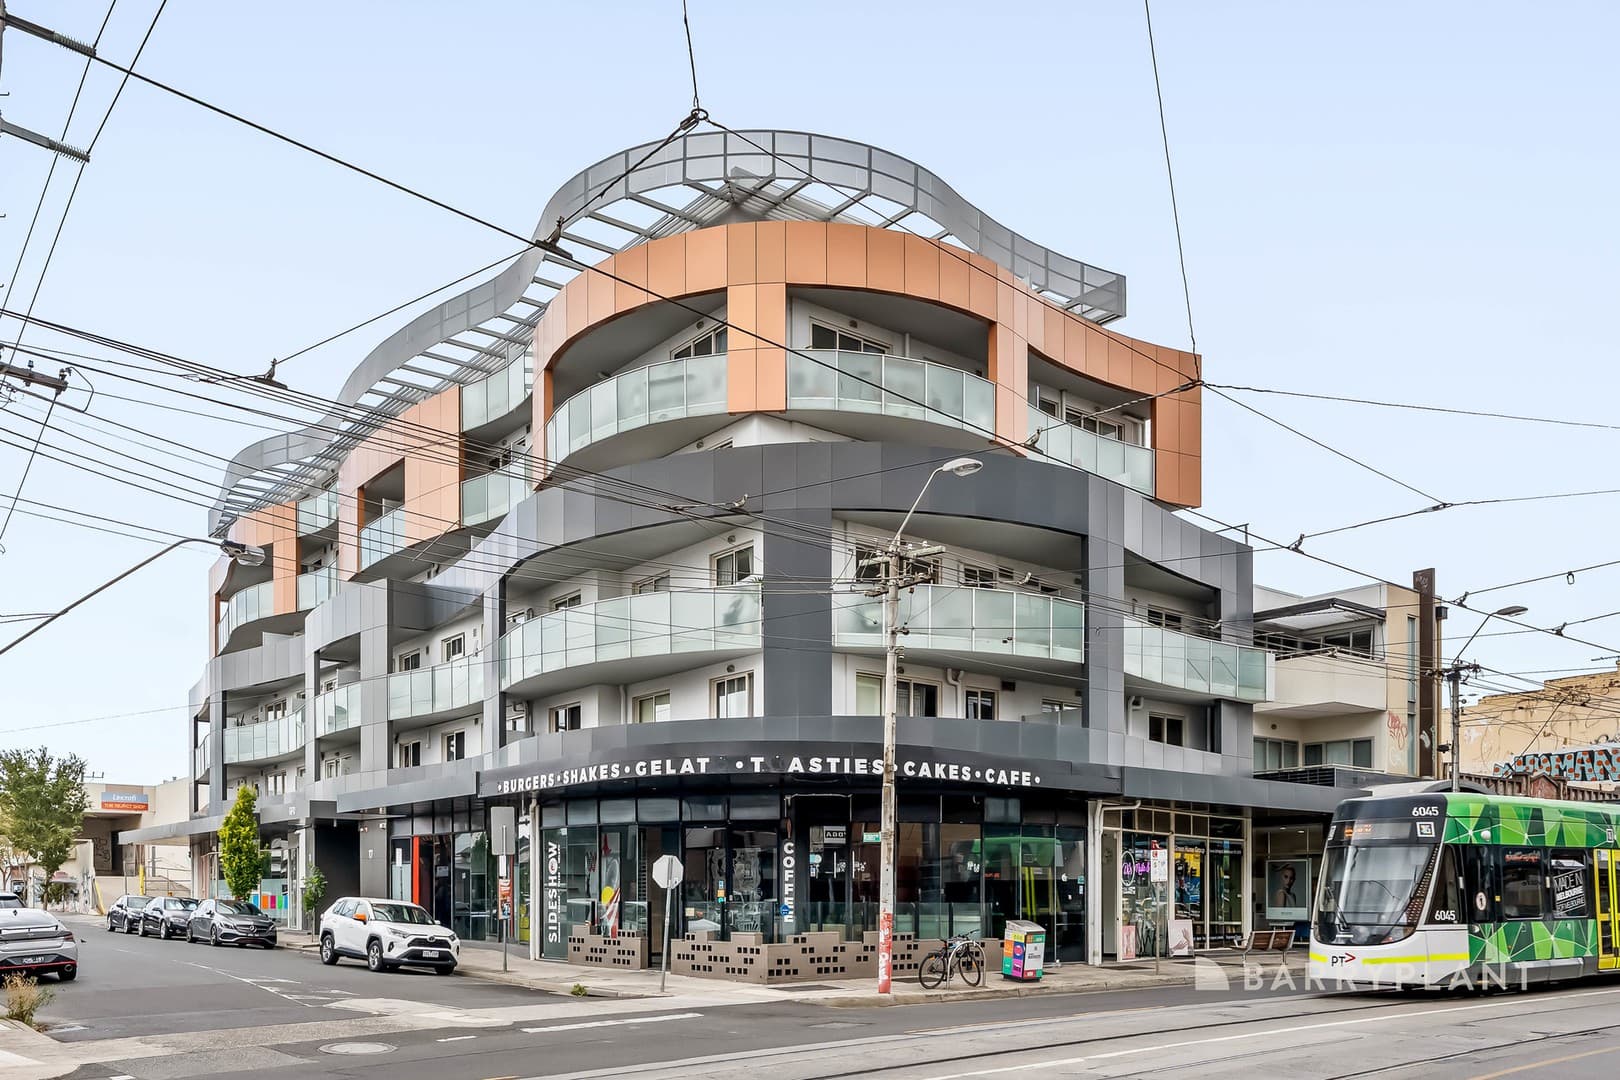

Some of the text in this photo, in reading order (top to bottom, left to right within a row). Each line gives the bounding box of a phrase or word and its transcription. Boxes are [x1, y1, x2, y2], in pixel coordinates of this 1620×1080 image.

[503, 773, 554, 794] BURGERS
[563, 763, 620, 785] SHAKES
[635, 757, 710, 776] GELAT
[903, 761, 972, 781] CAKES
[985, 768, 1031, 786] CAFE
[1412, 806, 1439, 817] 6045
[548, 841, 558, 943] SIDESHOW
[782, 841, 796, 923] COFFEE
[1556, 885, 1584, 901] MELBOURNE
[1434, 910, 1456, 921] 6045
